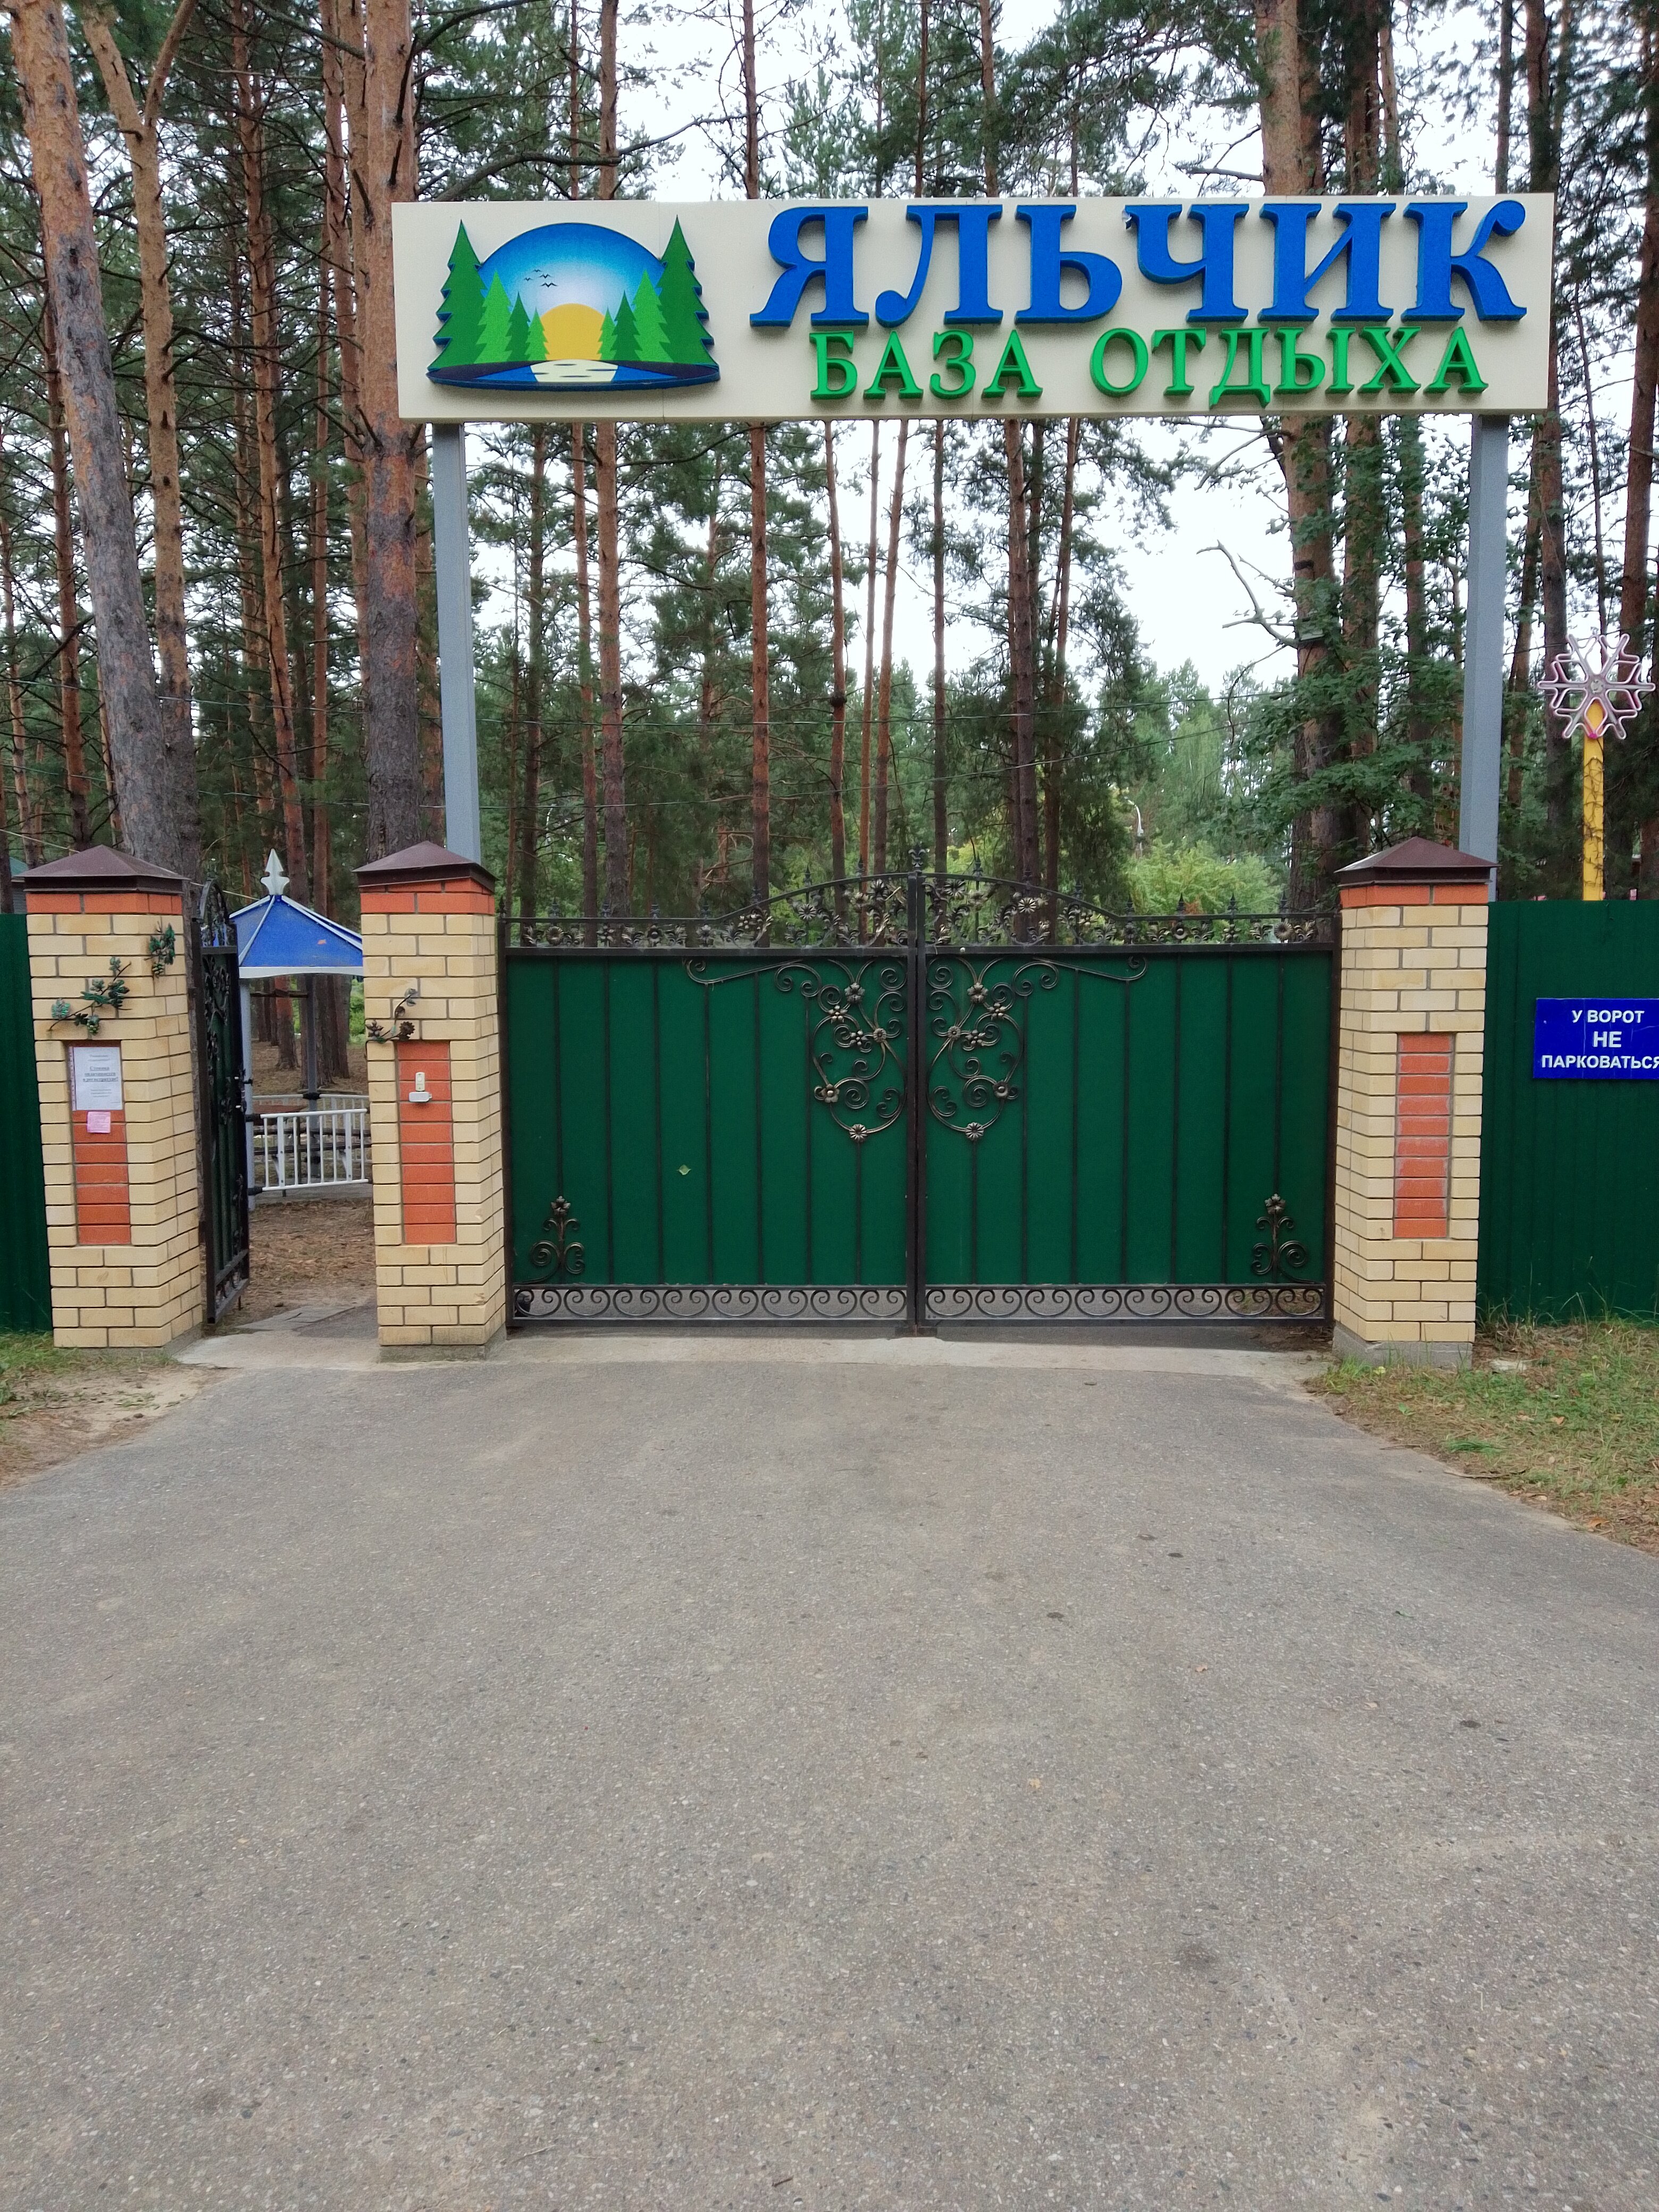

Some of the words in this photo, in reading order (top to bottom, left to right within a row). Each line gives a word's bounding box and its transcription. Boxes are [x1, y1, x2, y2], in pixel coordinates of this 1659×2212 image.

[750, 200, 1527, 325] ЯЛЬЧИК
[810, 329, 1043, 400] БАЗА
[1090, 326, 1488, 408] ОТДЫХА
[1572, 1010, 1583, 1023] У
[1587, 1010, 1645, 1023] ВОРОТ
[1593, 1031, 1622, 1048] НЕ
